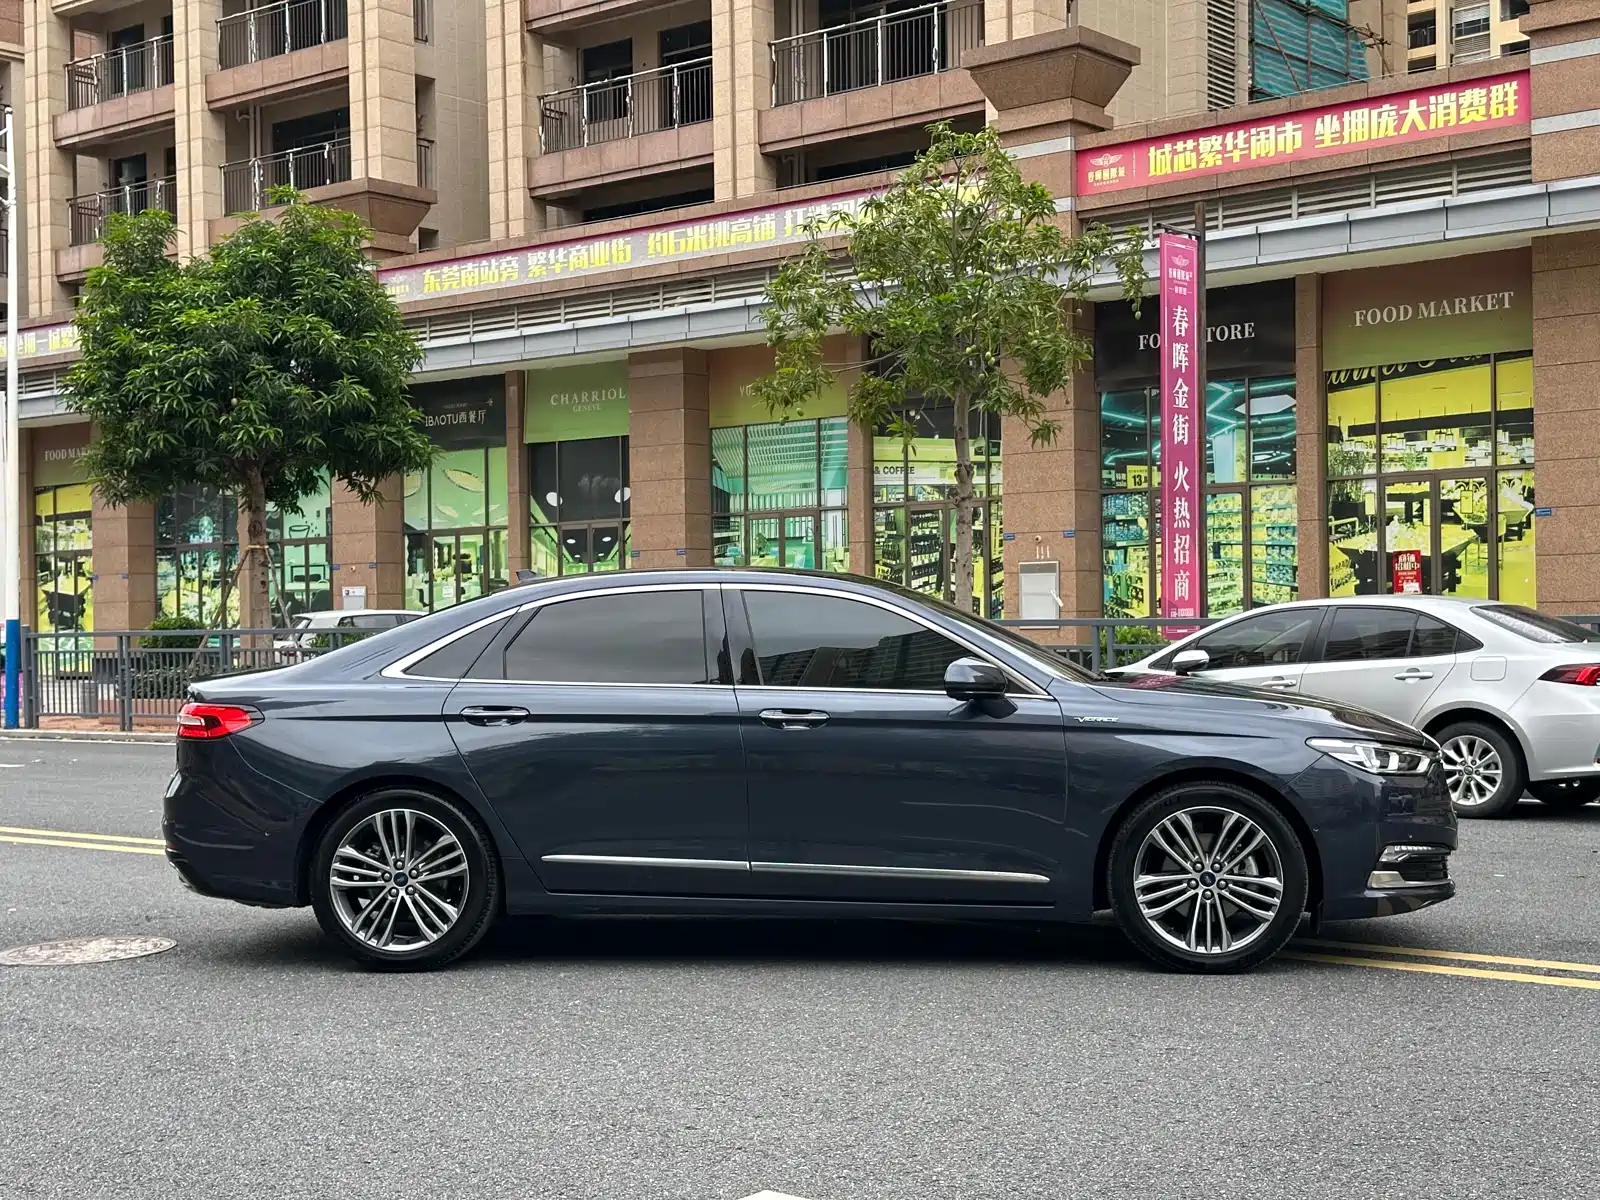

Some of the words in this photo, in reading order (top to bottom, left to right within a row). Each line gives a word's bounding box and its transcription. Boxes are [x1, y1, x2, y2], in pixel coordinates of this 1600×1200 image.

[1148, 121, 1303, 177] 城芯繁华闹市
[1314, 81, 1518, 149] 坐拥庞大消费群
[422, 256, 520, 294] 东莞南站旁
[527, 237, 632, 278] 繁华商业街
[647, 212, 776, 259] 约6米挑高铺
[1354, 304, 1413, 327] FOOD
[1417, 291, 1514, 319] MARKET
[1206, 322, 1255, 343] TORE
[1172, 305, 1190, 446] 春晖金街
[550, 387, 626, 406] CHARRIOL
[44, 448, 67, 461] FOOD
[883, 465, 915, 475] COFFE
[1173, 460, 1191, 602] 火热招商
